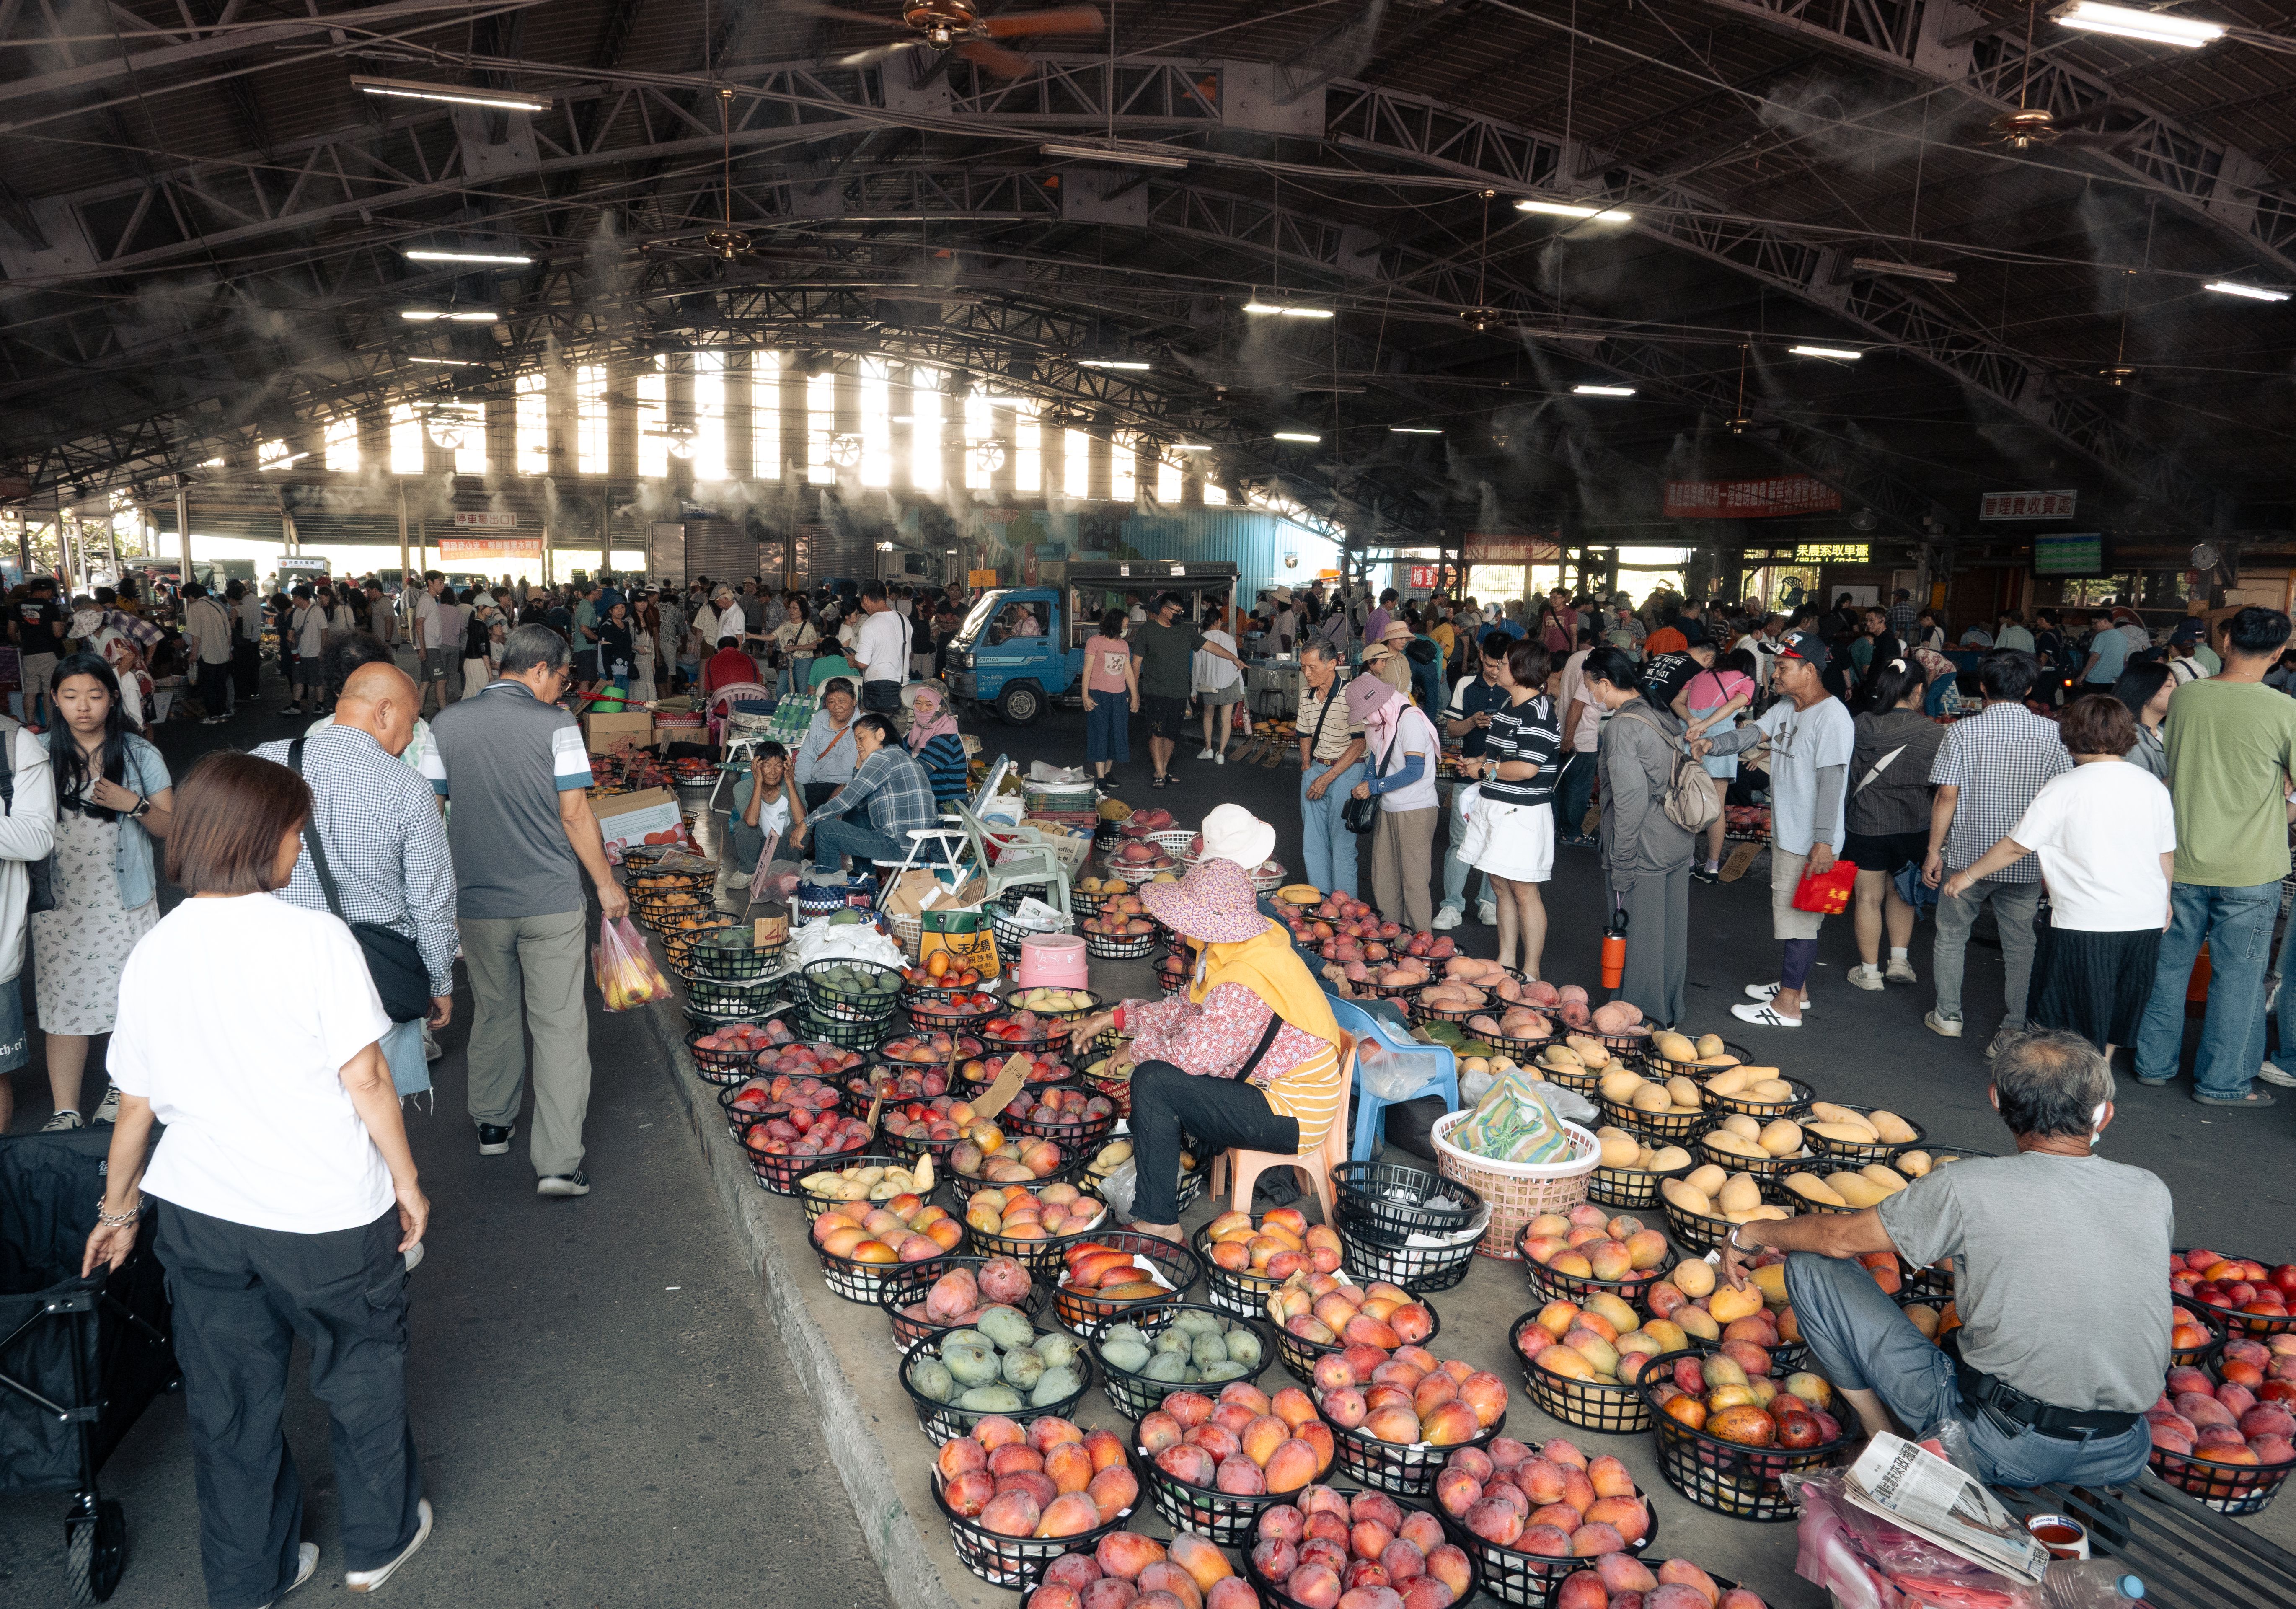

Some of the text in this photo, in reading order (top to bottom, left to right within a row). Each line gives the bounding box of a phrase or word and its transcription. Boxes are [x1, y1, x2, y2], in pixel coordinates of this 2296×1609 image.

[1985, 496, 2072, 515] 管理費收費處
[456, 513, 509, 525] 停車場出口
[1796, 544, 1869, 557] 果農索取單據
[1412, 569, 1433, 585] 埔里
[1874, 1442, 1920, 1499] 衝擊台灣未來政治版圖
